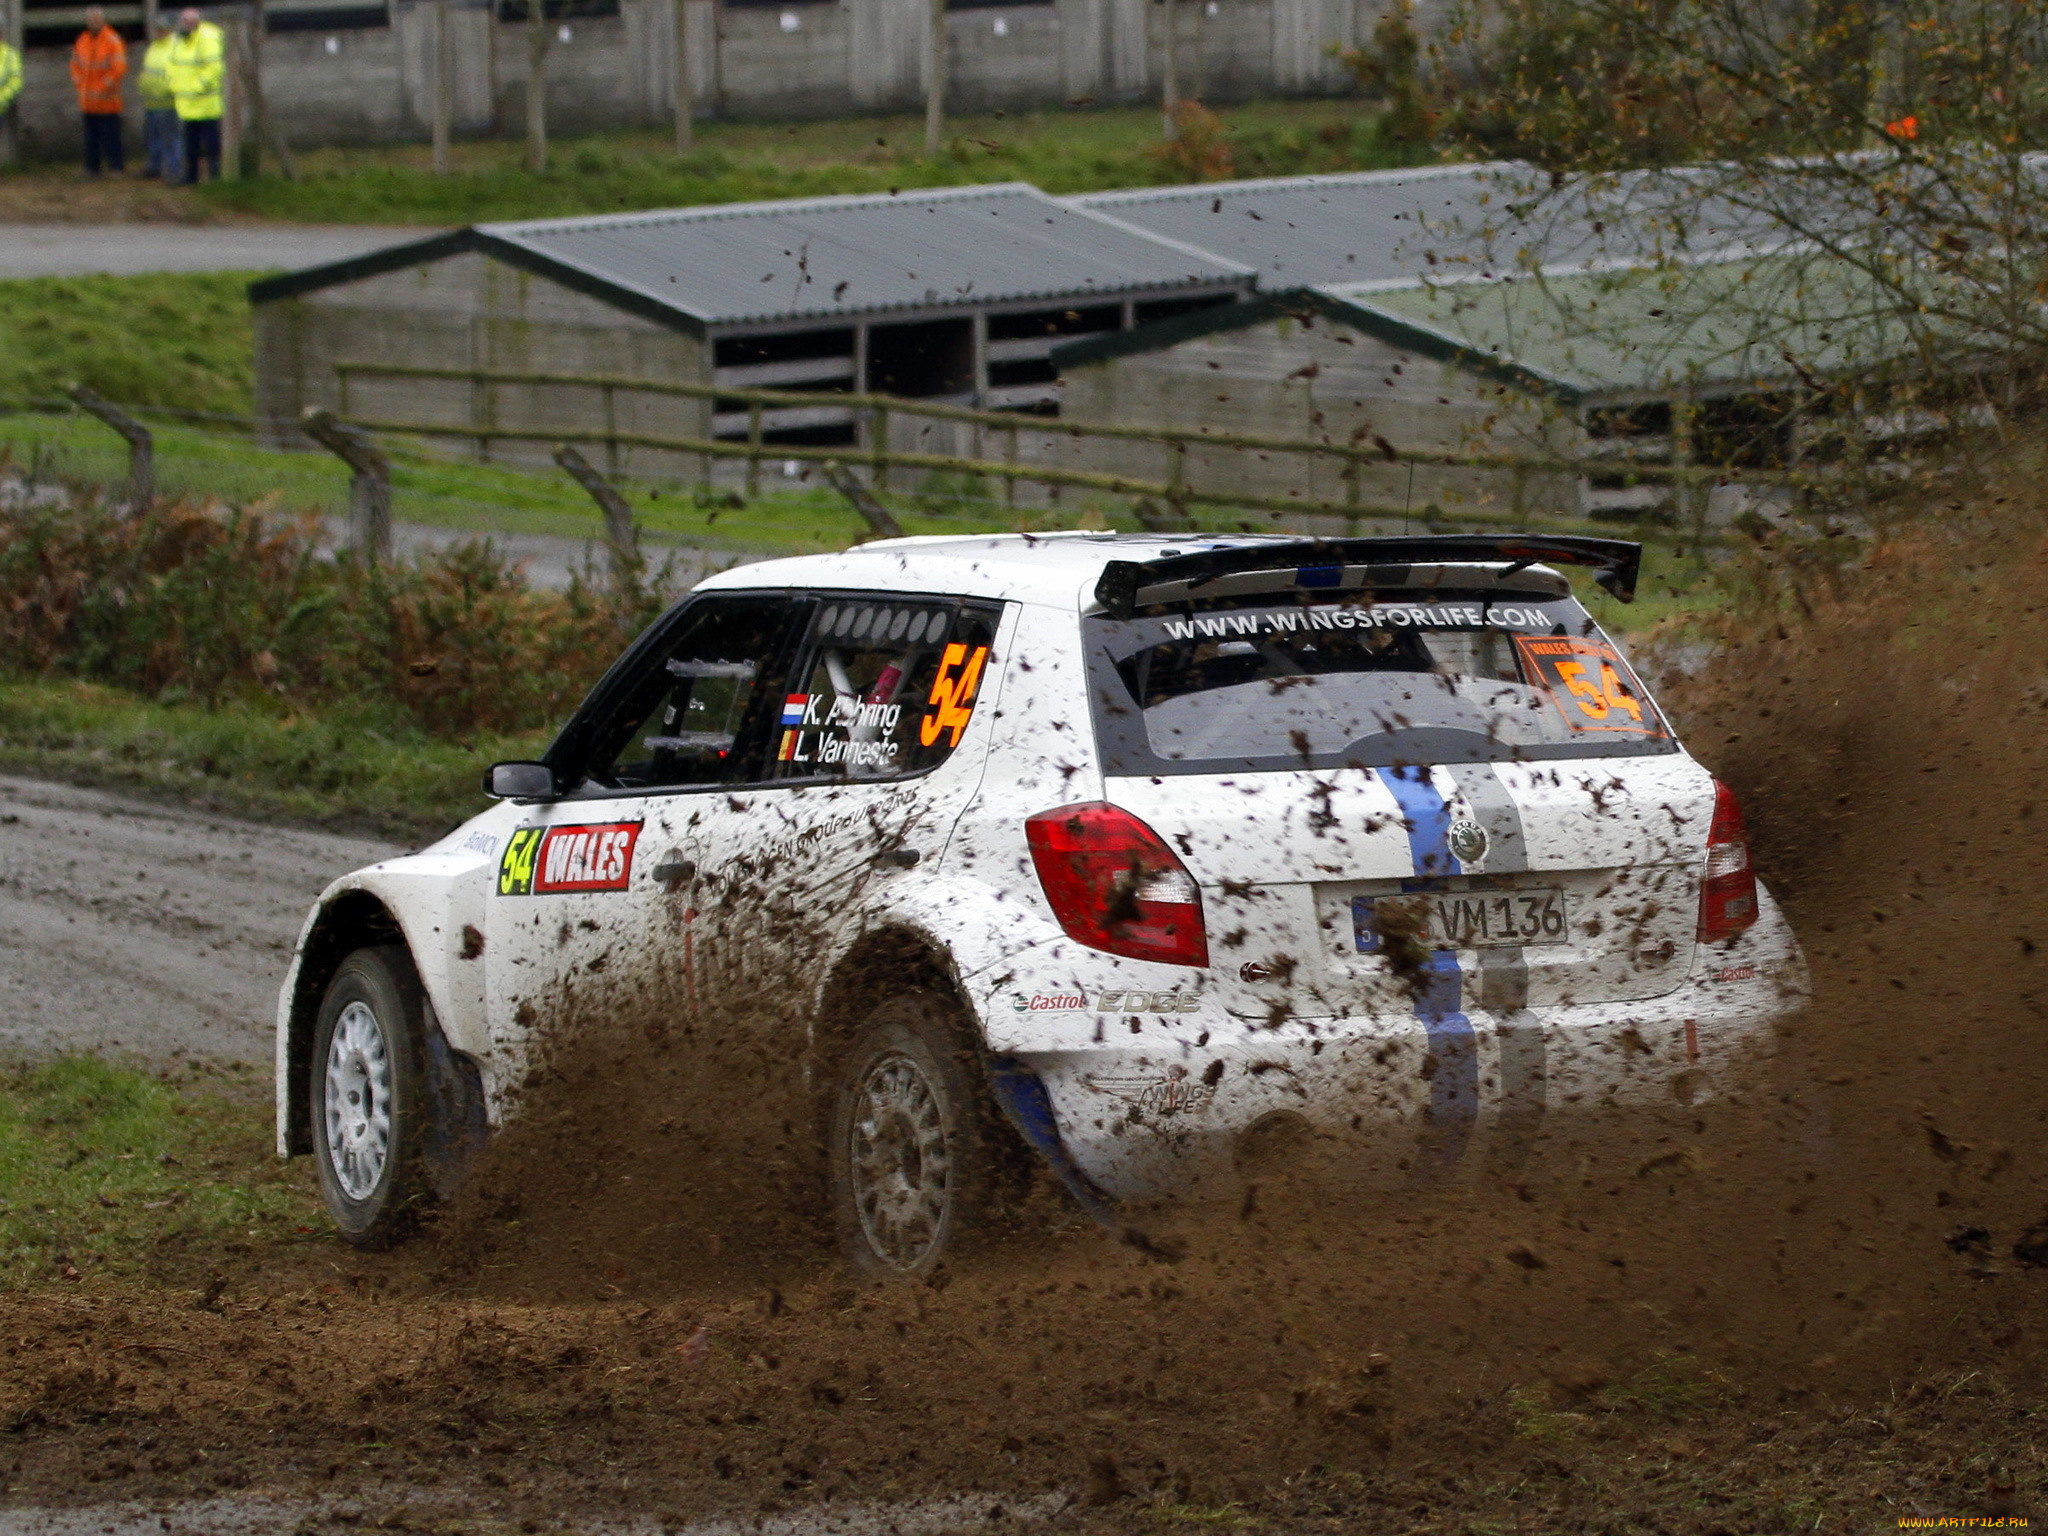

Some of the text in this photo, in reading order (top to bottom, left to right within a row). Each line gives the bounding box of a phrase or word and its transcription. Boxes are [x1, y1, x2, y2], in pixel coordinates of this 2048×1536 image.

[1163, 606, 1552, 640] WWW.WINGSFORLIFE.COM
[802, 693, 902, 737] K. Abring
[919, 643, 988, 748] 54
[1554, 661, 1643, 722] 54
[793, 730, 809, 762] L.
[501, 828, 541, 894] 54
[544, 830, 629, 883] WALES
[1029, 990, 1204, 1014] Castrol EDGE
